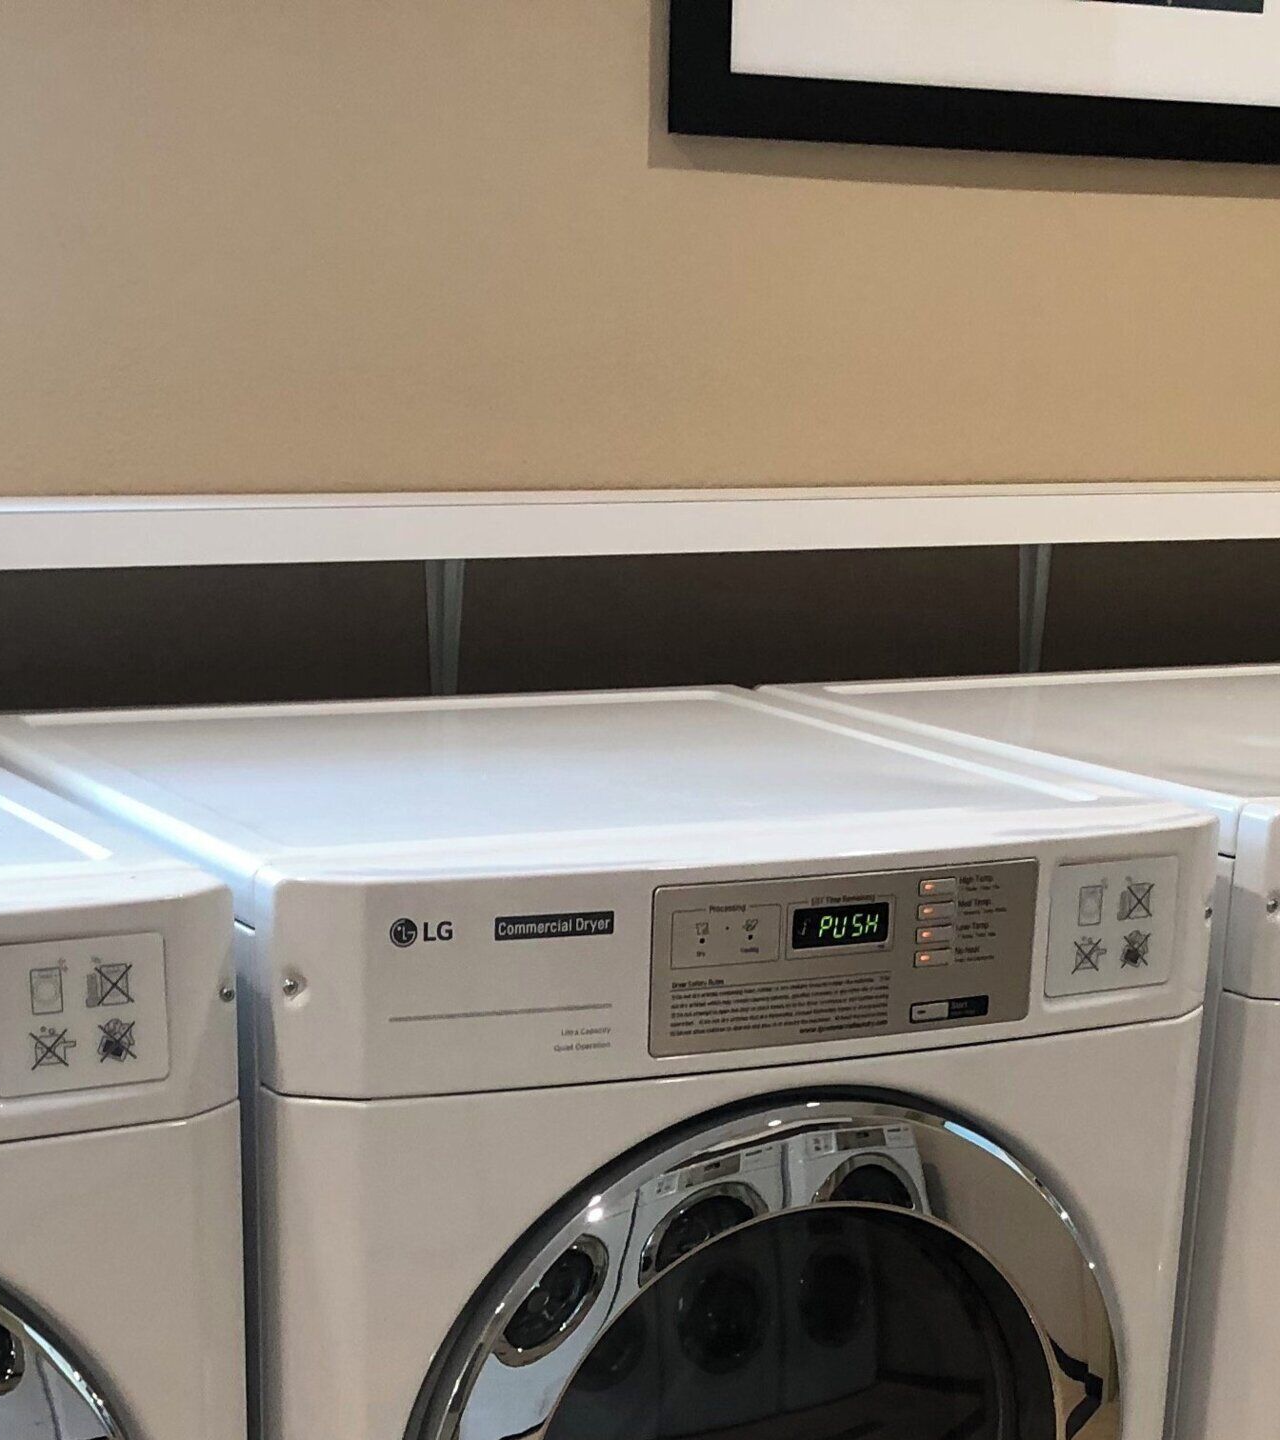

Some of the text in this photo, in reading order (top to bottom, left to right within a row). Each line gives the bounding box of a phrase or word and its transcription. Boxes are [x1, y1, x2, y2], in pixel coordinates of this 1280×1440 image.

[423, 921, 453, 942] LG
[498, 917, 612, 936] Commercial Dryer
[819, 913, 879, 939] PUSH
